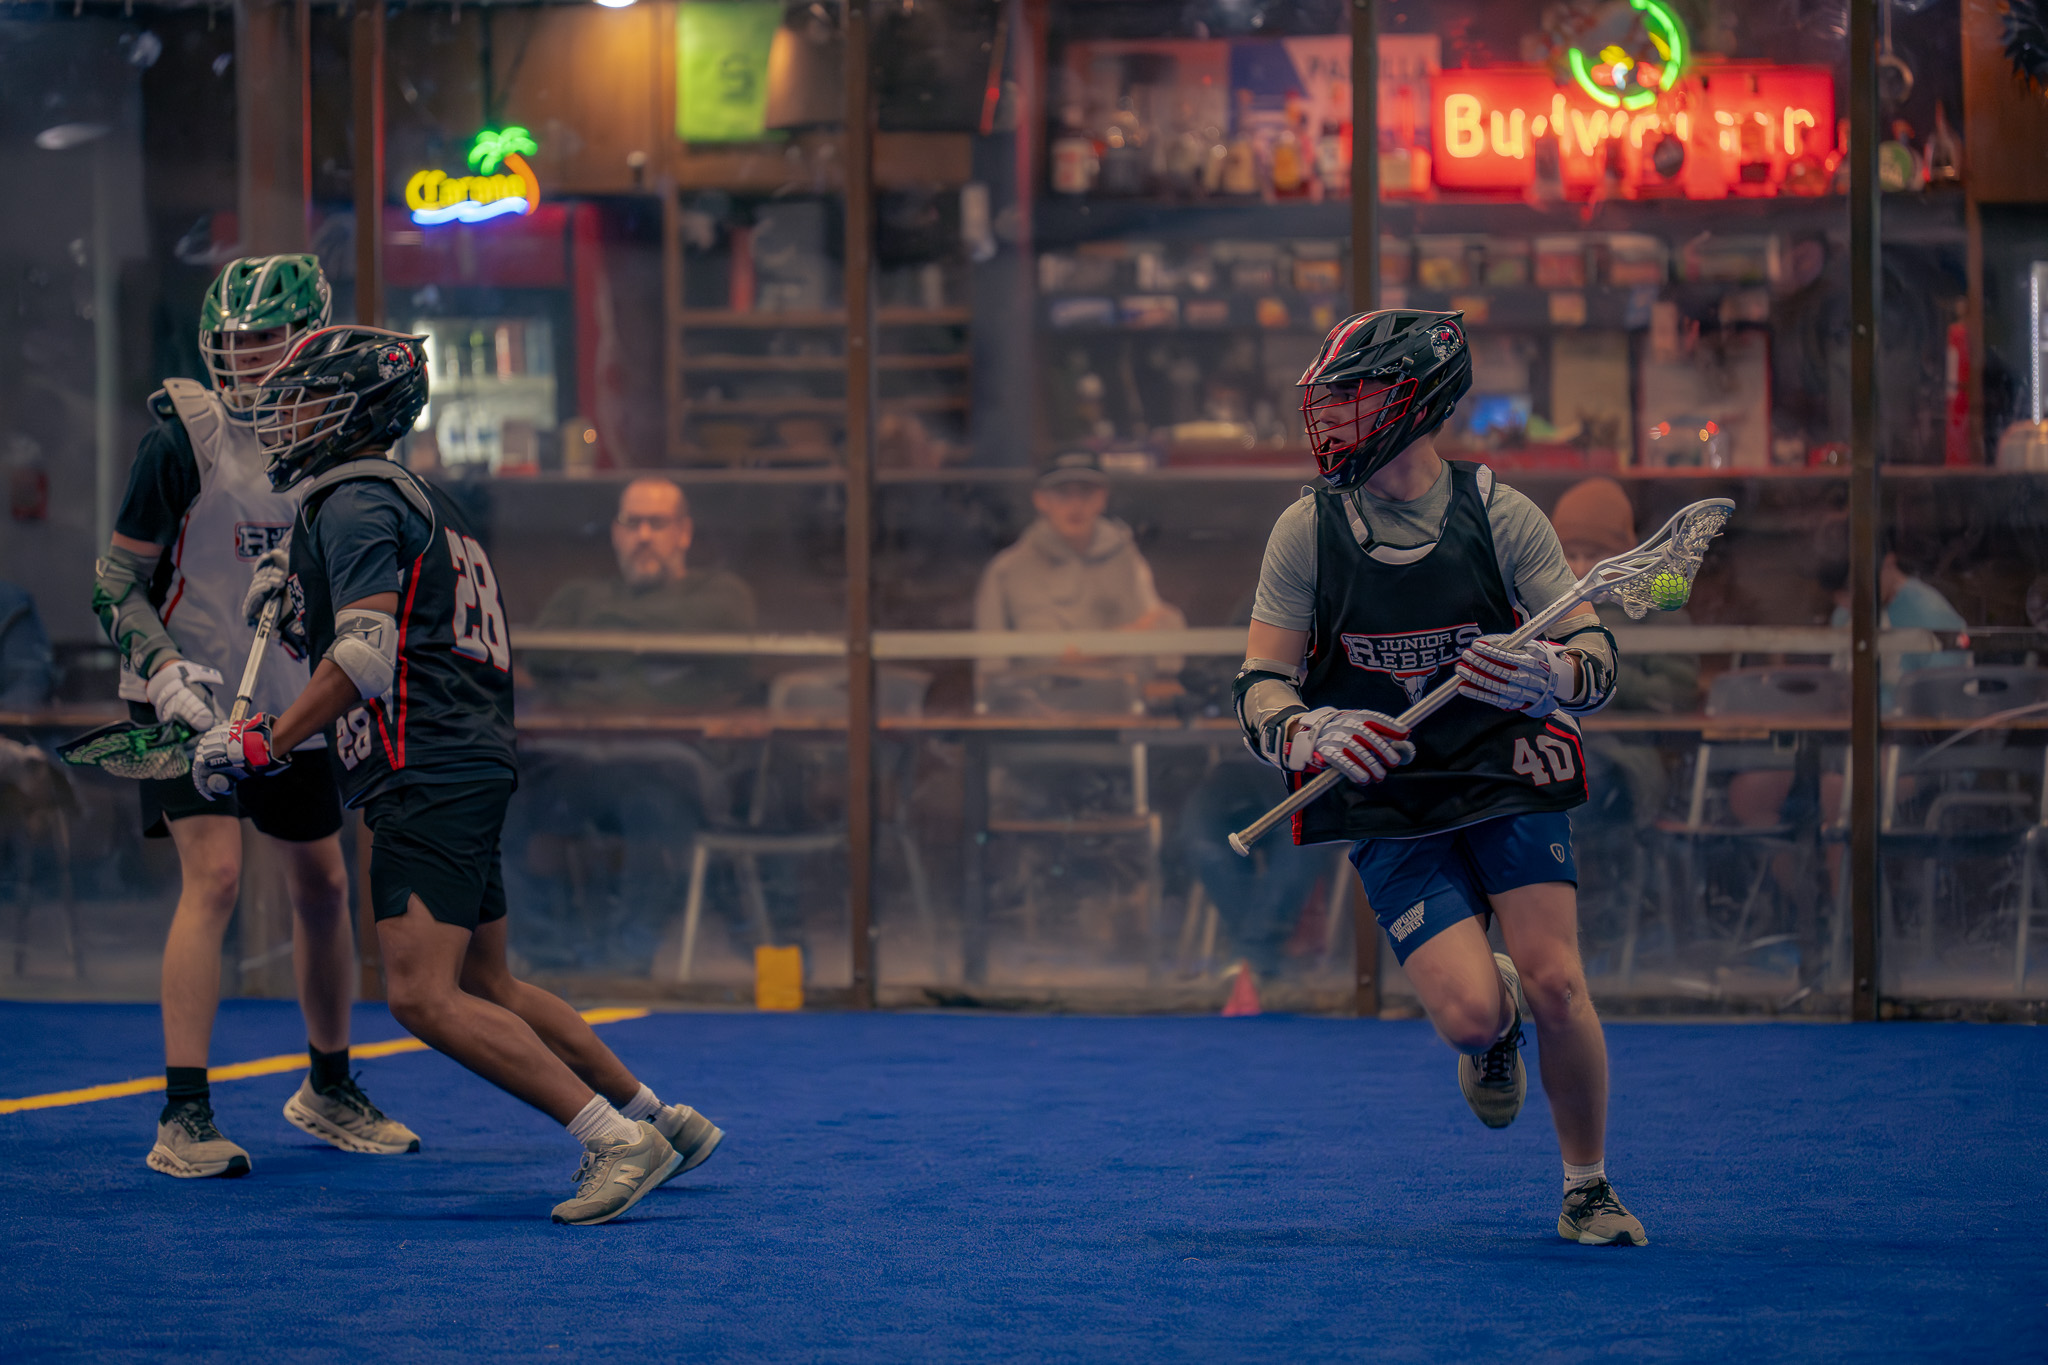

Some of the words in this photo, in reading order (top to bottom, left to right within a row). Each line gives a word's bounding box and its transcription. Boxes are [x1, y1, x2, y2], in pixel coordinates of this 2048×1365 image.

[444, 526, 510, 672] 28
[1376, 632, 1453, 652] JUNIOR
[335, 706, 372, 771] 28
[1512, 734, 1576, 786] 40
[1389, 900, 1425, 938] TOPGUN
